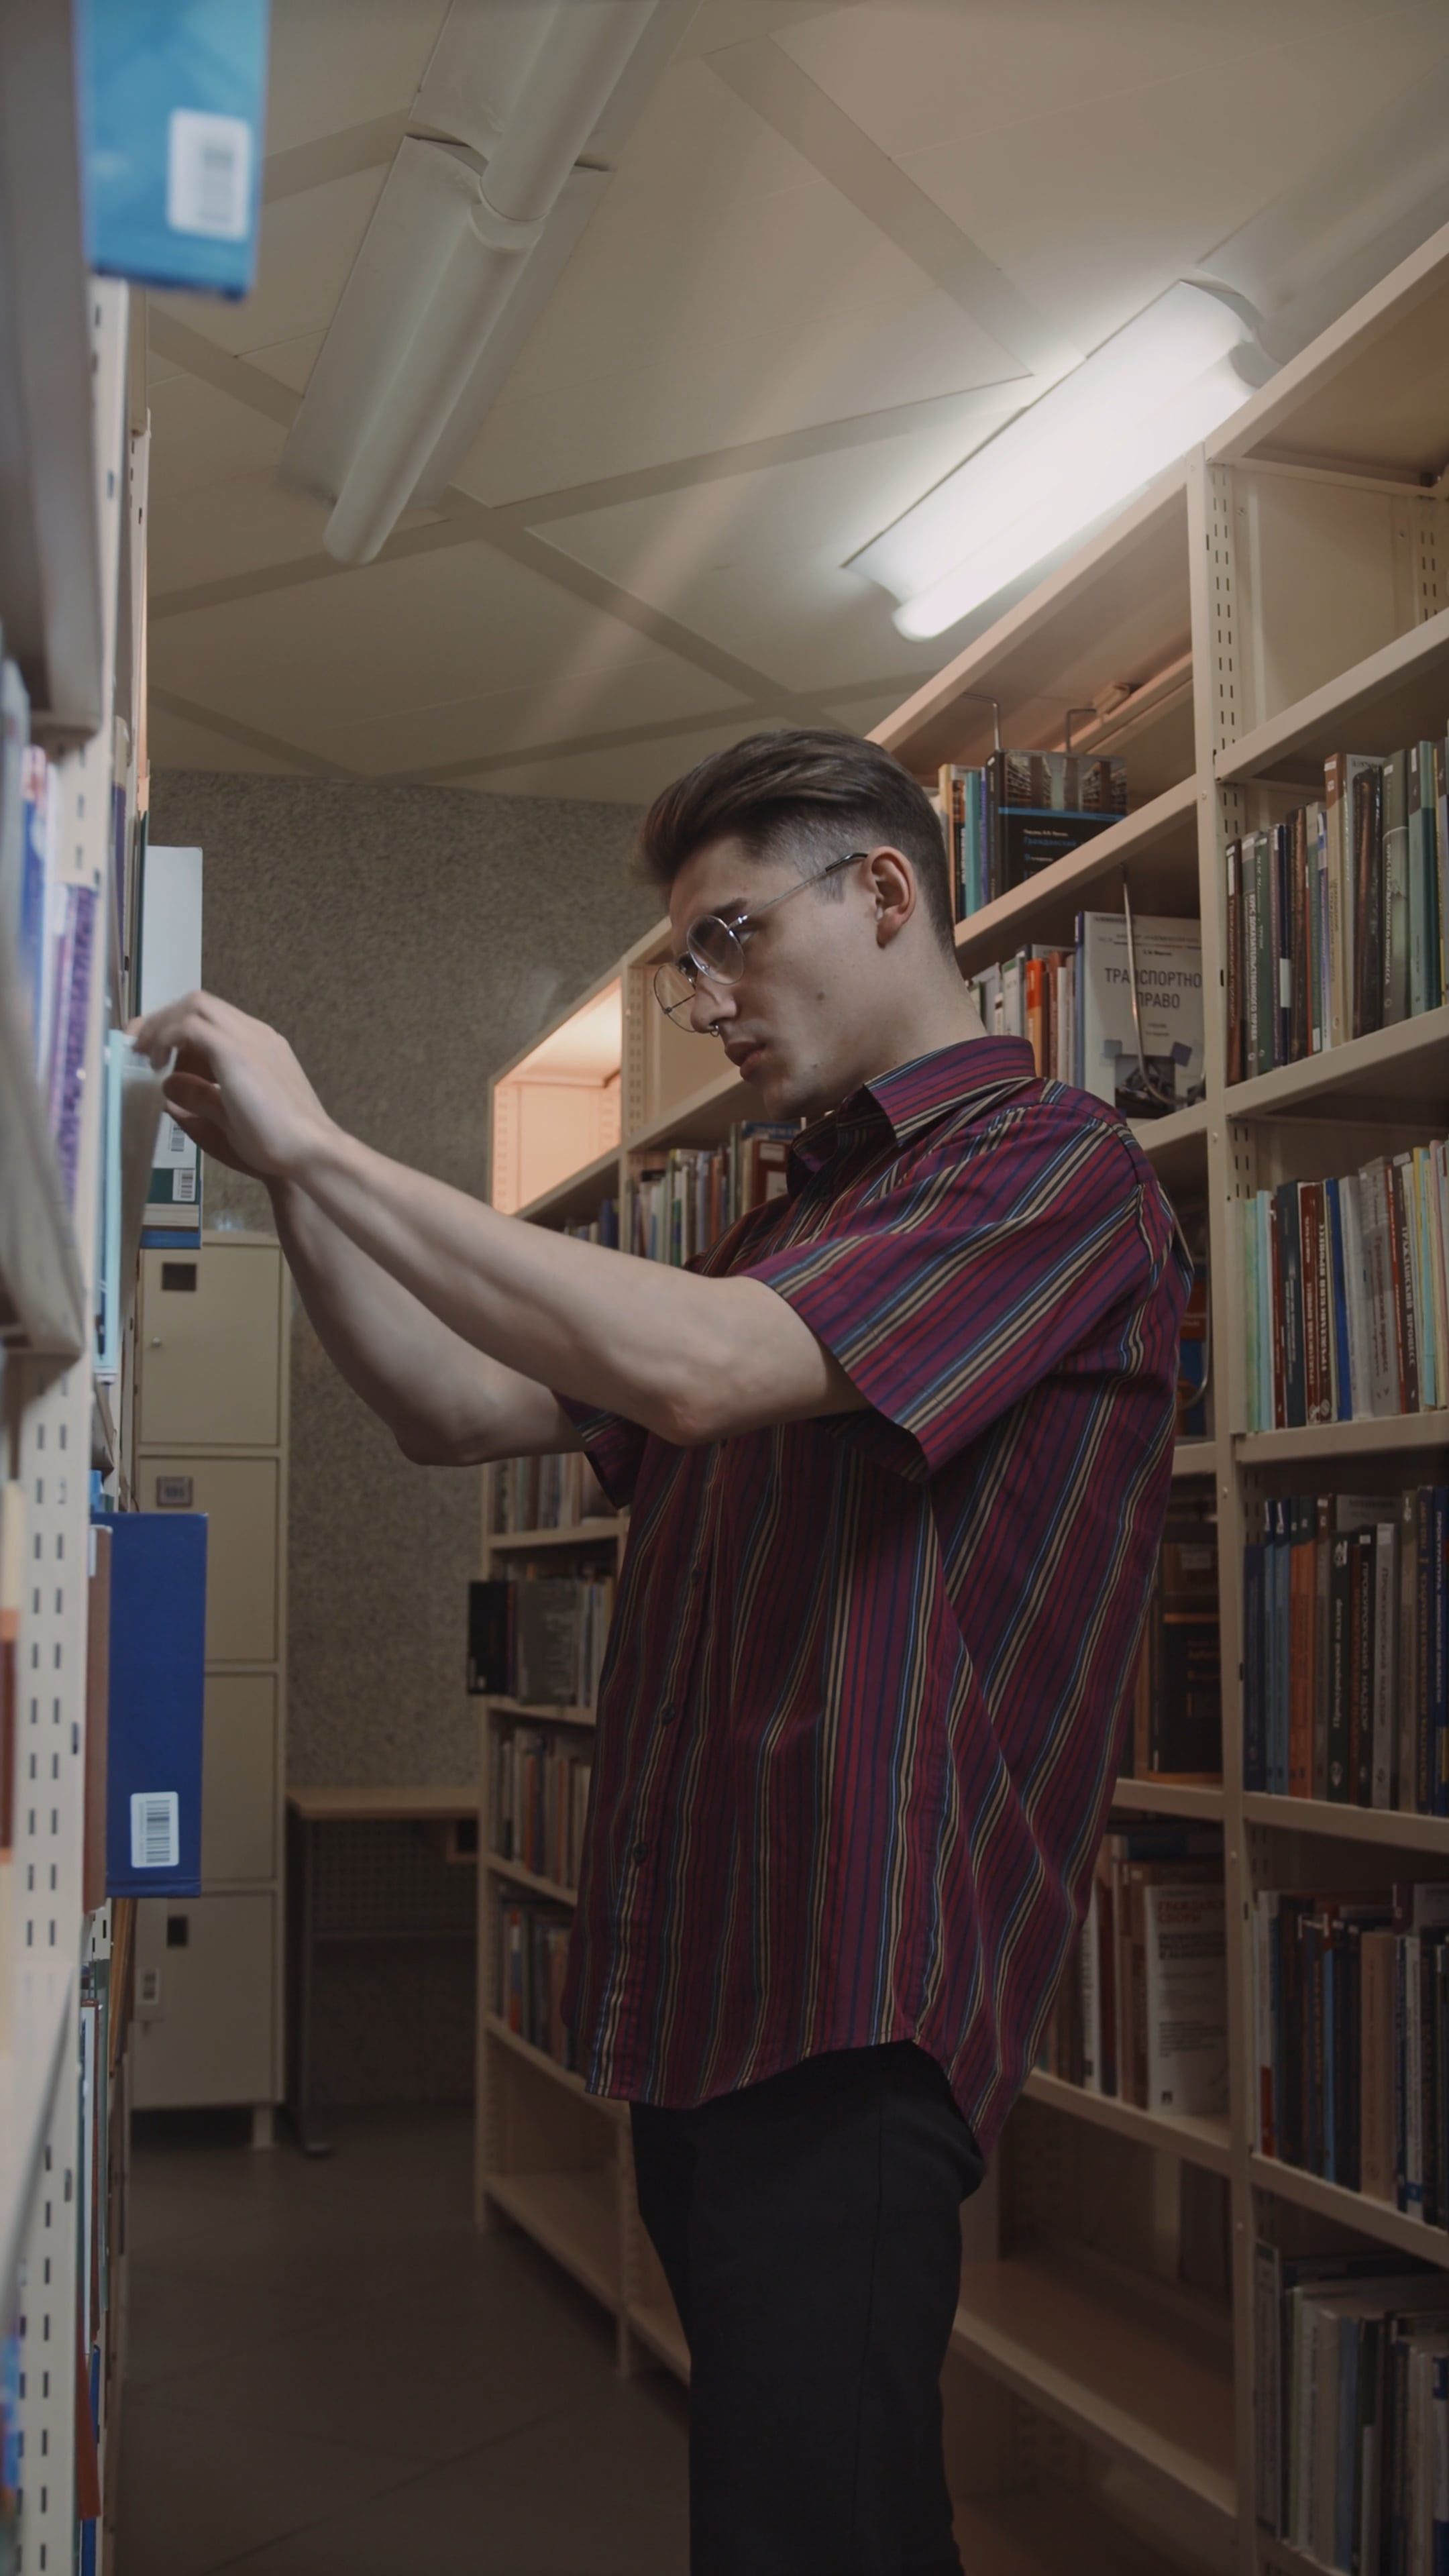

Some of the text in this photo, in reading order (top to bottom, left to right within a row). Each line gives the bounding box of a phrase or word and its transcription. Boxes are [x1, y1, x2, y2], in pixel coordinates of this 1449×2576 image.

[1136, 991, 1181, 1009] ПРАВО
[1401, 1226, 1415, 1367] ГРАЖДАНСКИЙ ПРОЦЕСС
[1361, 1561, 1369, 1670] ПРОКУРОРСКИЙ
